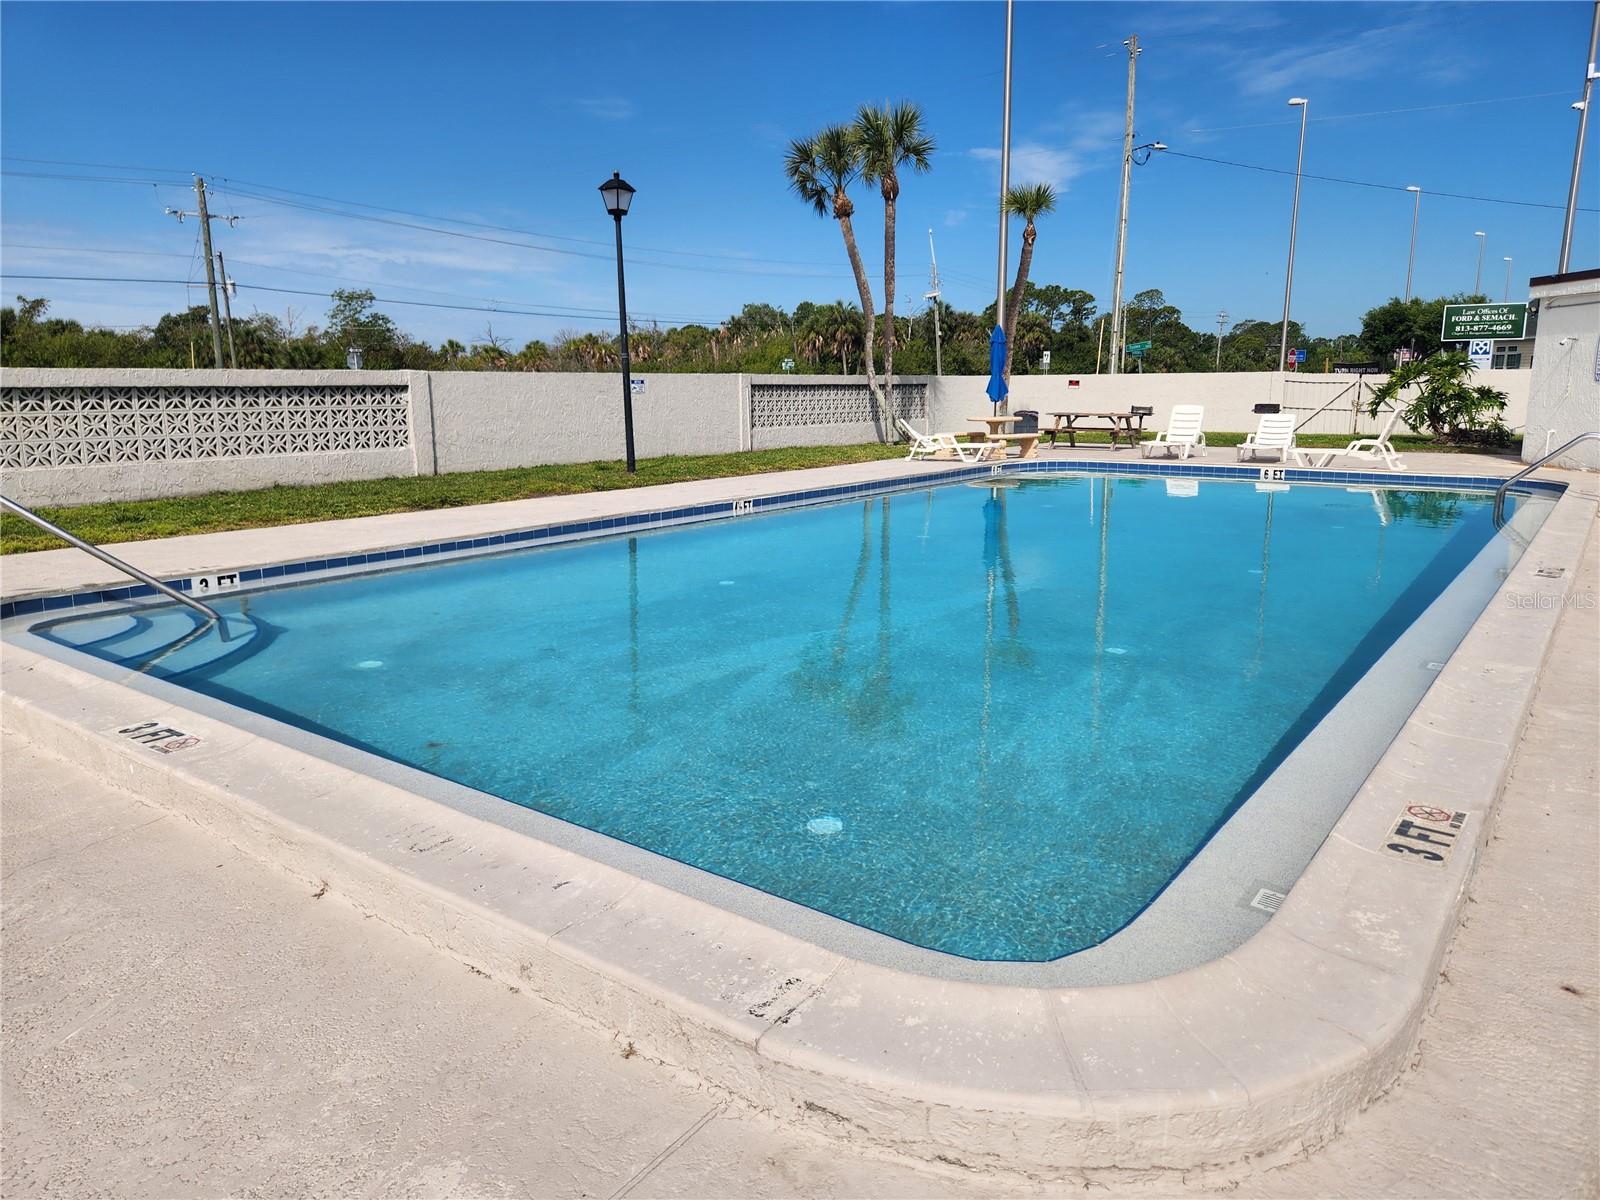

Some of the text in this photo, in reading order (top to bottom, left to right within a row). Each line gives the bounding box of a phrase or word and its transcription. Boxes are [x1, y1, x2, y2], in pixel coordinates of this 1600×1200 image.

[118, 723, 185, 744] 3 FT
[1387, 820, 1456, 861] 3 FT
